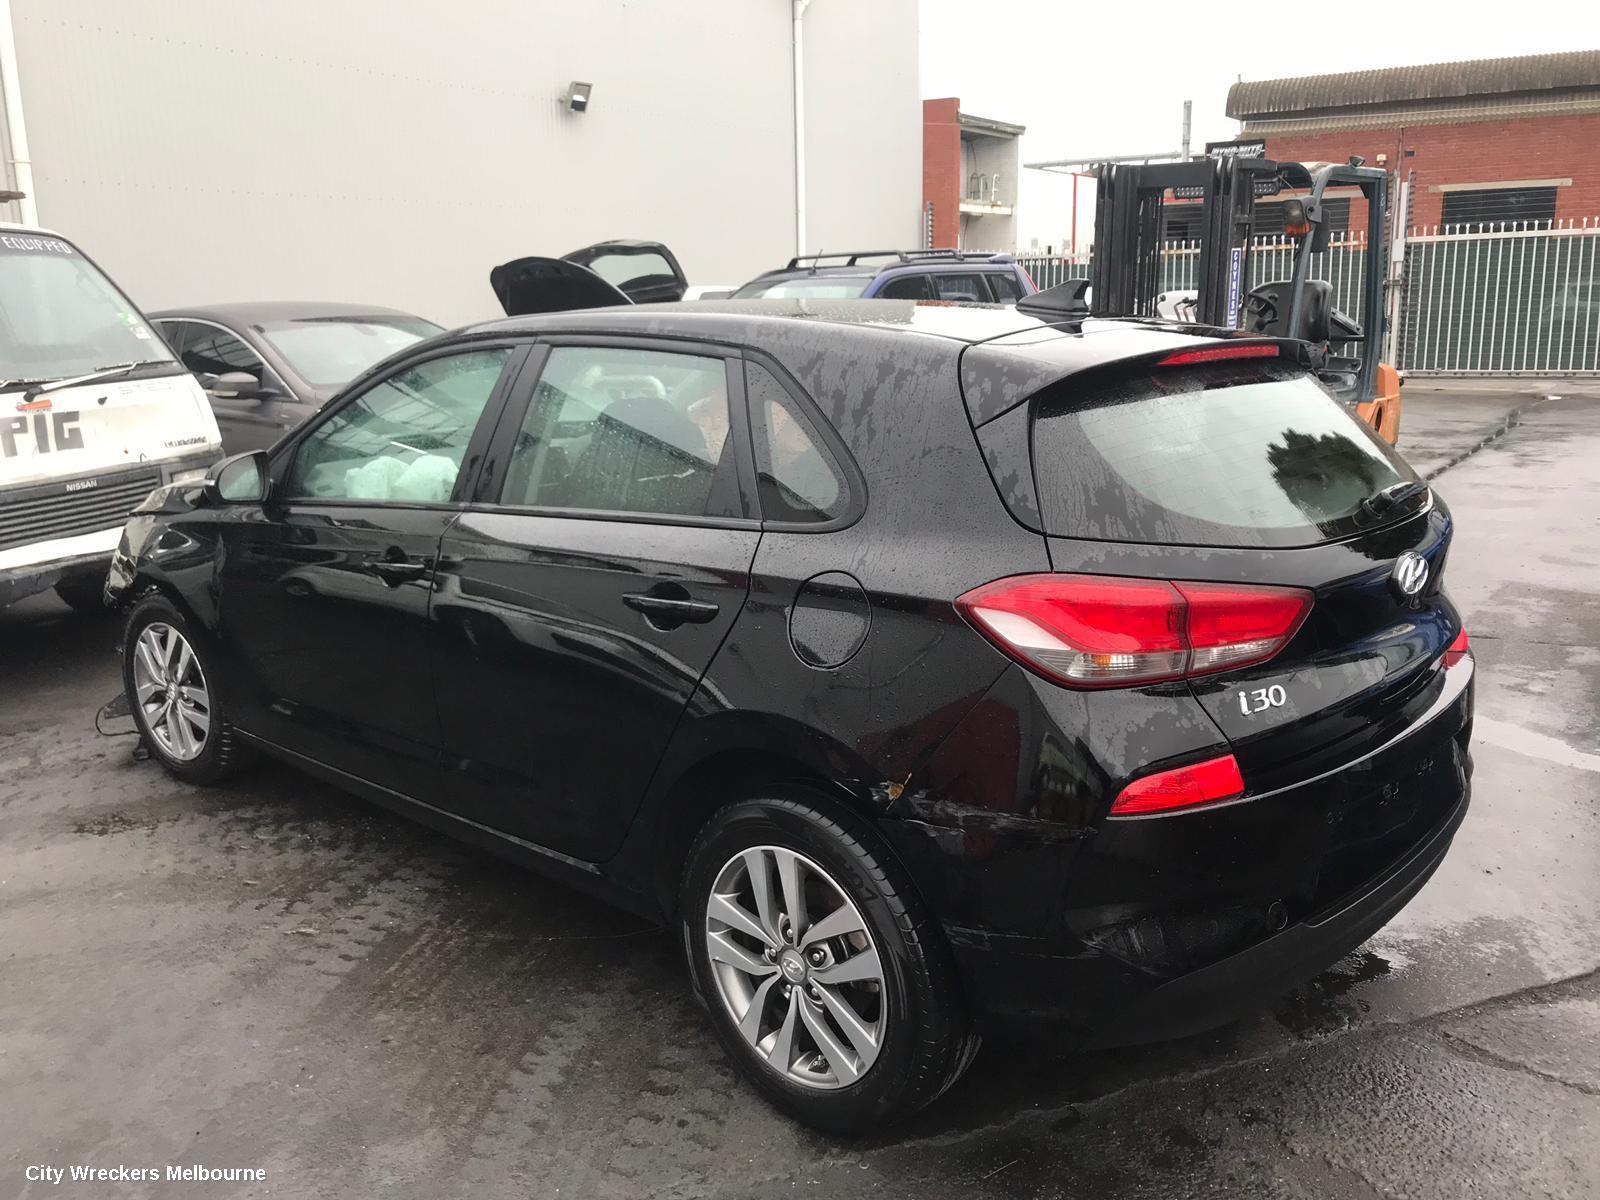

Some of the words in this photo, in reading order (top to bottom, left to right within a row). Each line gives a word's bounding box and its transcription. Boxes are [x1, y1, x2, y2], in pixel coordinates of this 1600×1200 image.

[1, 236, 72, 254] EQUIPPED
[0, 411, 84, 458] PIG
[66, 480, 97, 491] NISSAN
[1238, 684, 1286, 715] i30
